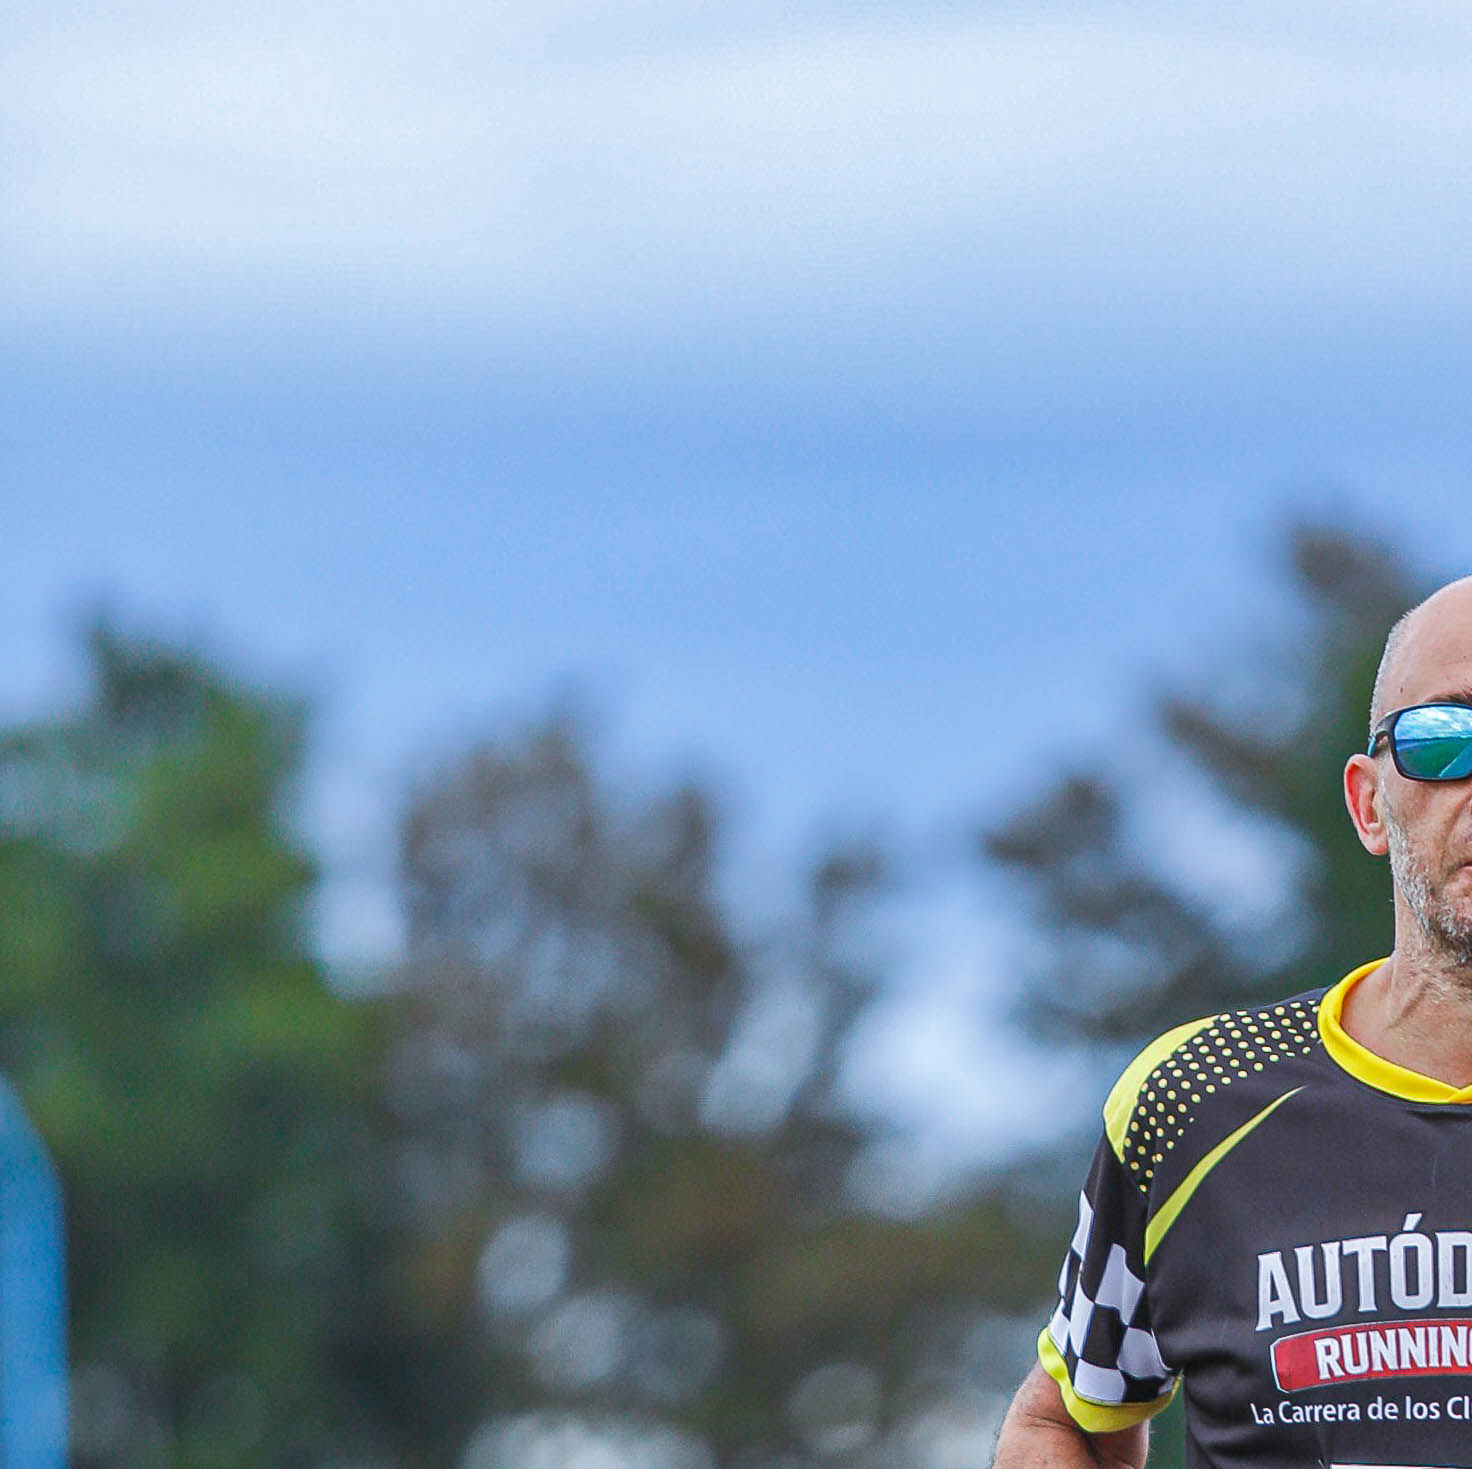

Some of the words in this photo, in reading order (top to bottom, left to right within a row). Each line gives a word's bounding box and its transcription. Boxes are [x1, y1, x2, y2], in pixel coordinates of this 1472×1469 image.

[1250, 1402, 1275, 1426] La
[1278, 1400, 1361, 1424] Carrera
[1367, 1396, 1399, 1420] de
[1405, 1396, 1440, 1420] los
